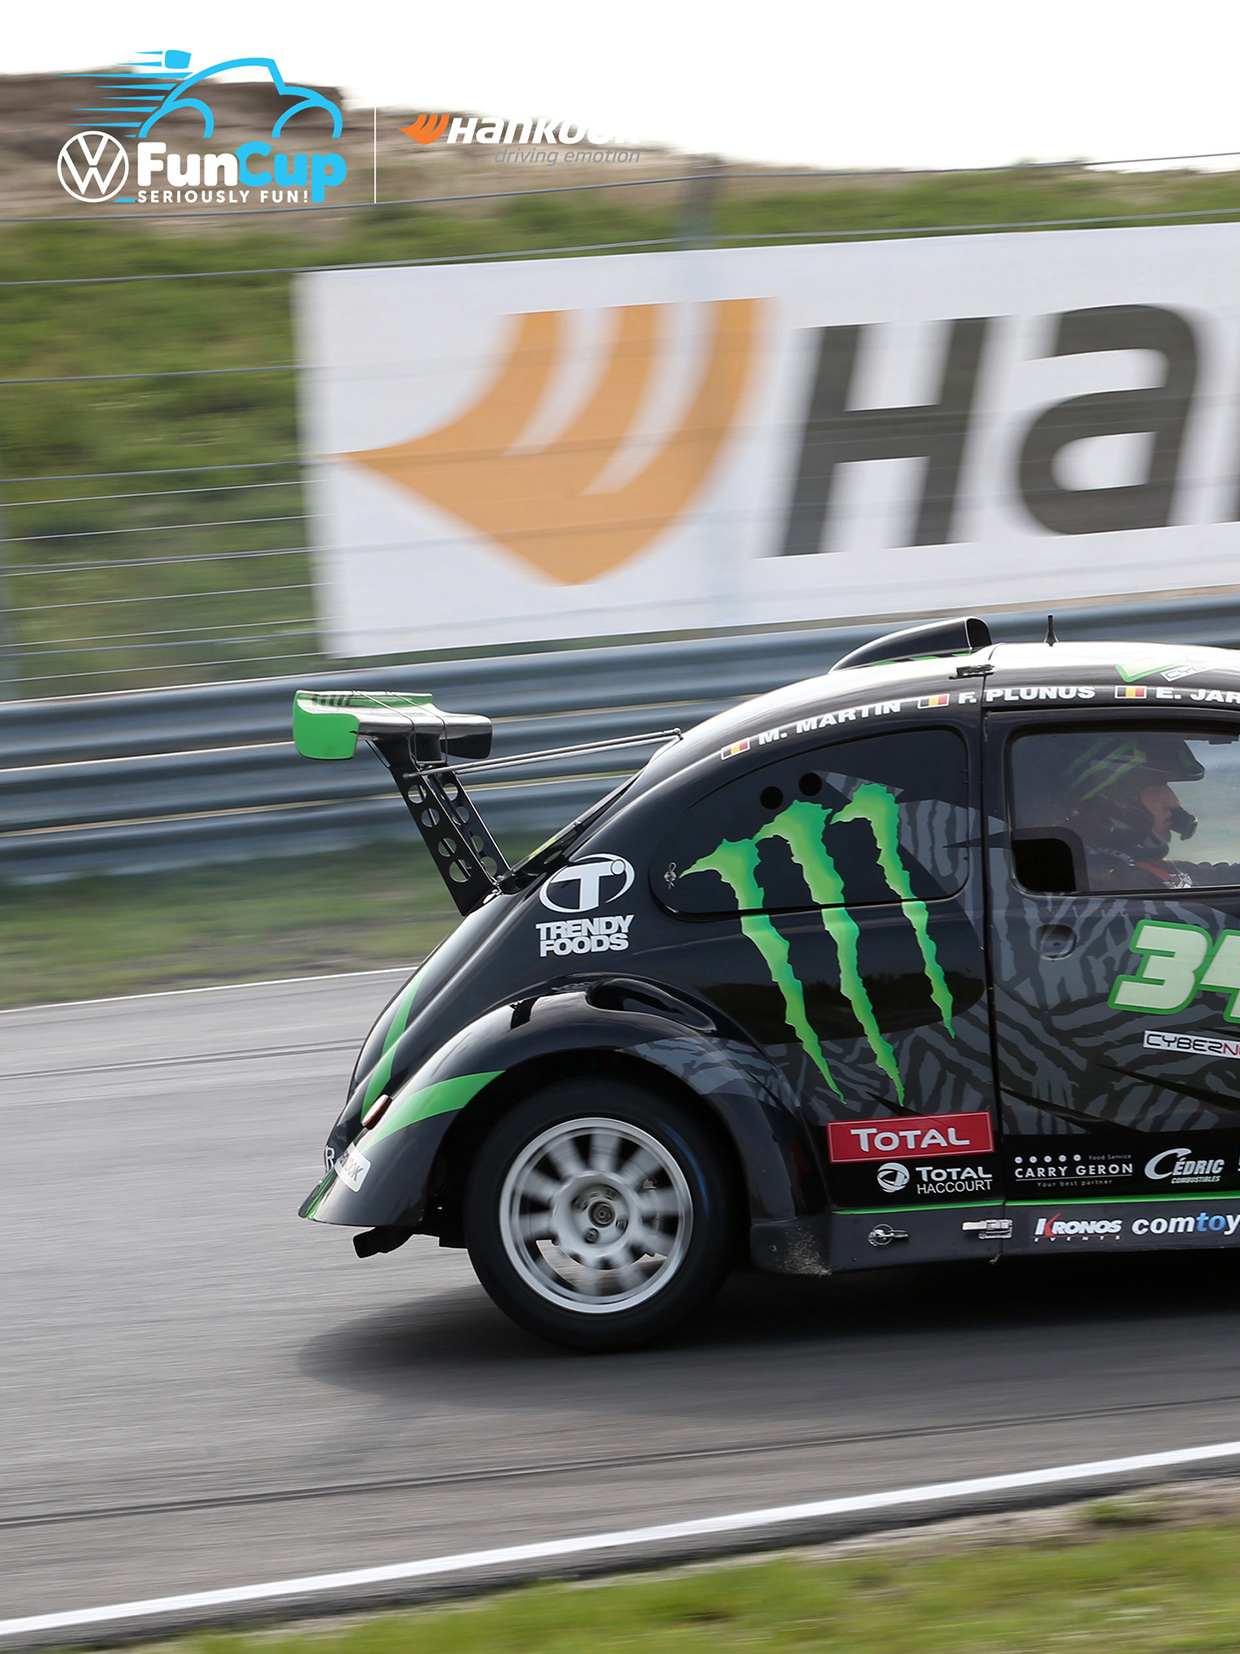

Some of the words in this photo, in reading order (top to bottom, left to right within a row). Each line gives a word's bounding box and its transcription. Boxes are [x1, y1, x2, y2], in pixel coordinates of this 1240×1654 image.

[958, 692, 977, 705] F.
[985, 686, 1096, 702] PLUNUS
[1155, 688, 1182, 700] E.
[758, 730, 788, 746] M.
[796, 702, 901, 734] MARTIN
[536, 914, 634, 941] TRENDY
[540, 932, 629, 957] FOODS
[850, 1127, 970, 1152] TOTAL
[915, 1166, 993, 1182] TOTAL
[1014, 1166, 1068, 1179] CARRY
[1076, 1163, 1133, 1176] GERON
[917, 1179, 993, 1195] HACCOURT
[1081, 1178, 1112, 1187] partner
[1034, 1213, 1123, 1237] KRONOS
